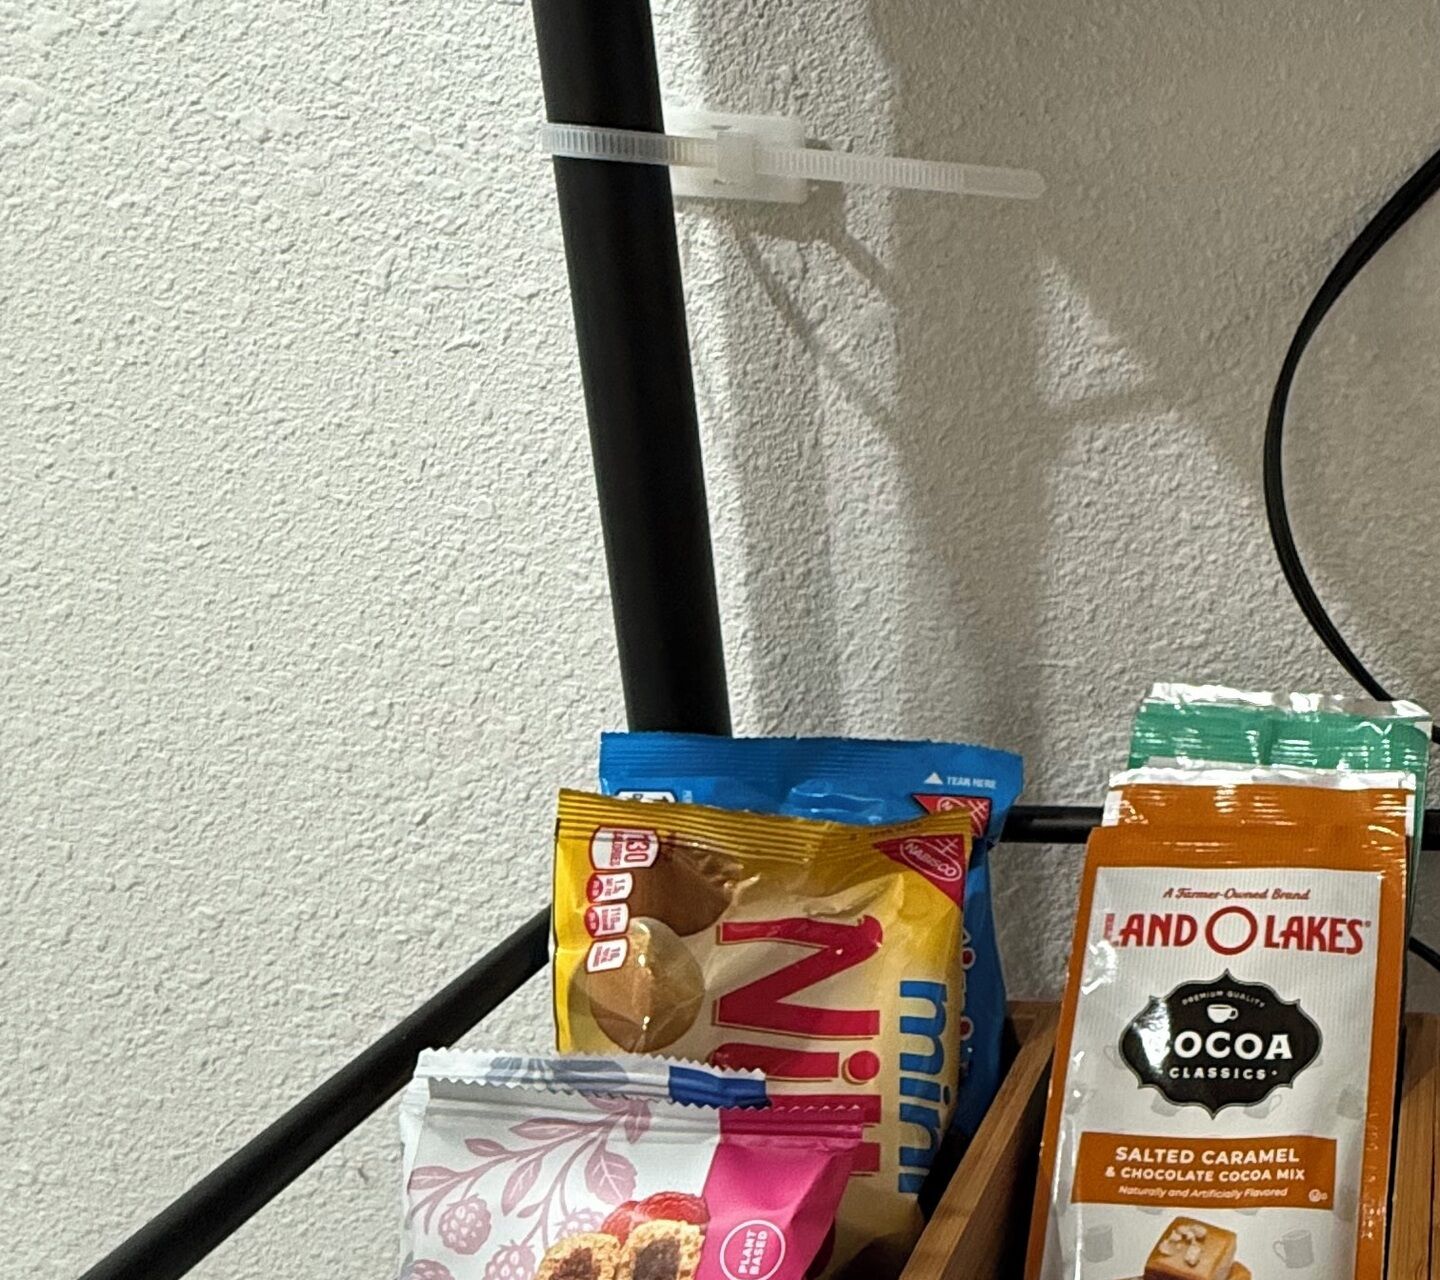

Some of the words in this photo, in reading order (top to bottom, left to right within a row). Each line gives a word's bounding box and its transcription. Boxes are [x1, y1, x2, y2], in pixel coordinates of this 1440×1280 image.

[623, 833, 650, 863] 130
[904, 842, 957, 877] NABISCO
[1176, 887, 1268, 900] Farmer-Owned
[1272, 888, 1311, 900] Brand
[1104, 913, 1198, 948] LAND
[1205, 906, 1258, 956] O
[1264, 914, 1364, 956] LAKES
[1182, 990, 1224, 1006] PREMIUM
[1146, 1030, 1293, 1061] OCOA
[1169, 1067, 1266, 1081] CLASSICS
[1115, 1146, 1195, 1164] SALTED
[1201, 1148, 1300, 1166] CARAMEL
[1105, 1166, 1116, 1178] &
[1120, 1166, 1214, 1182] CHOCOLATE
[1218, 1168, 1272, 1182] COCOA
[1276, 1168, 1306, 1181] MIX
[1118, 1185, 1167, 1199] Naturally
[1168, 1186, 1190, 1198] and
[1243, 1187, 1289, 1198] Flavored
[738, 1230, 758, 1274] PLANT
[749, 1230, 769, 1275] BASED
